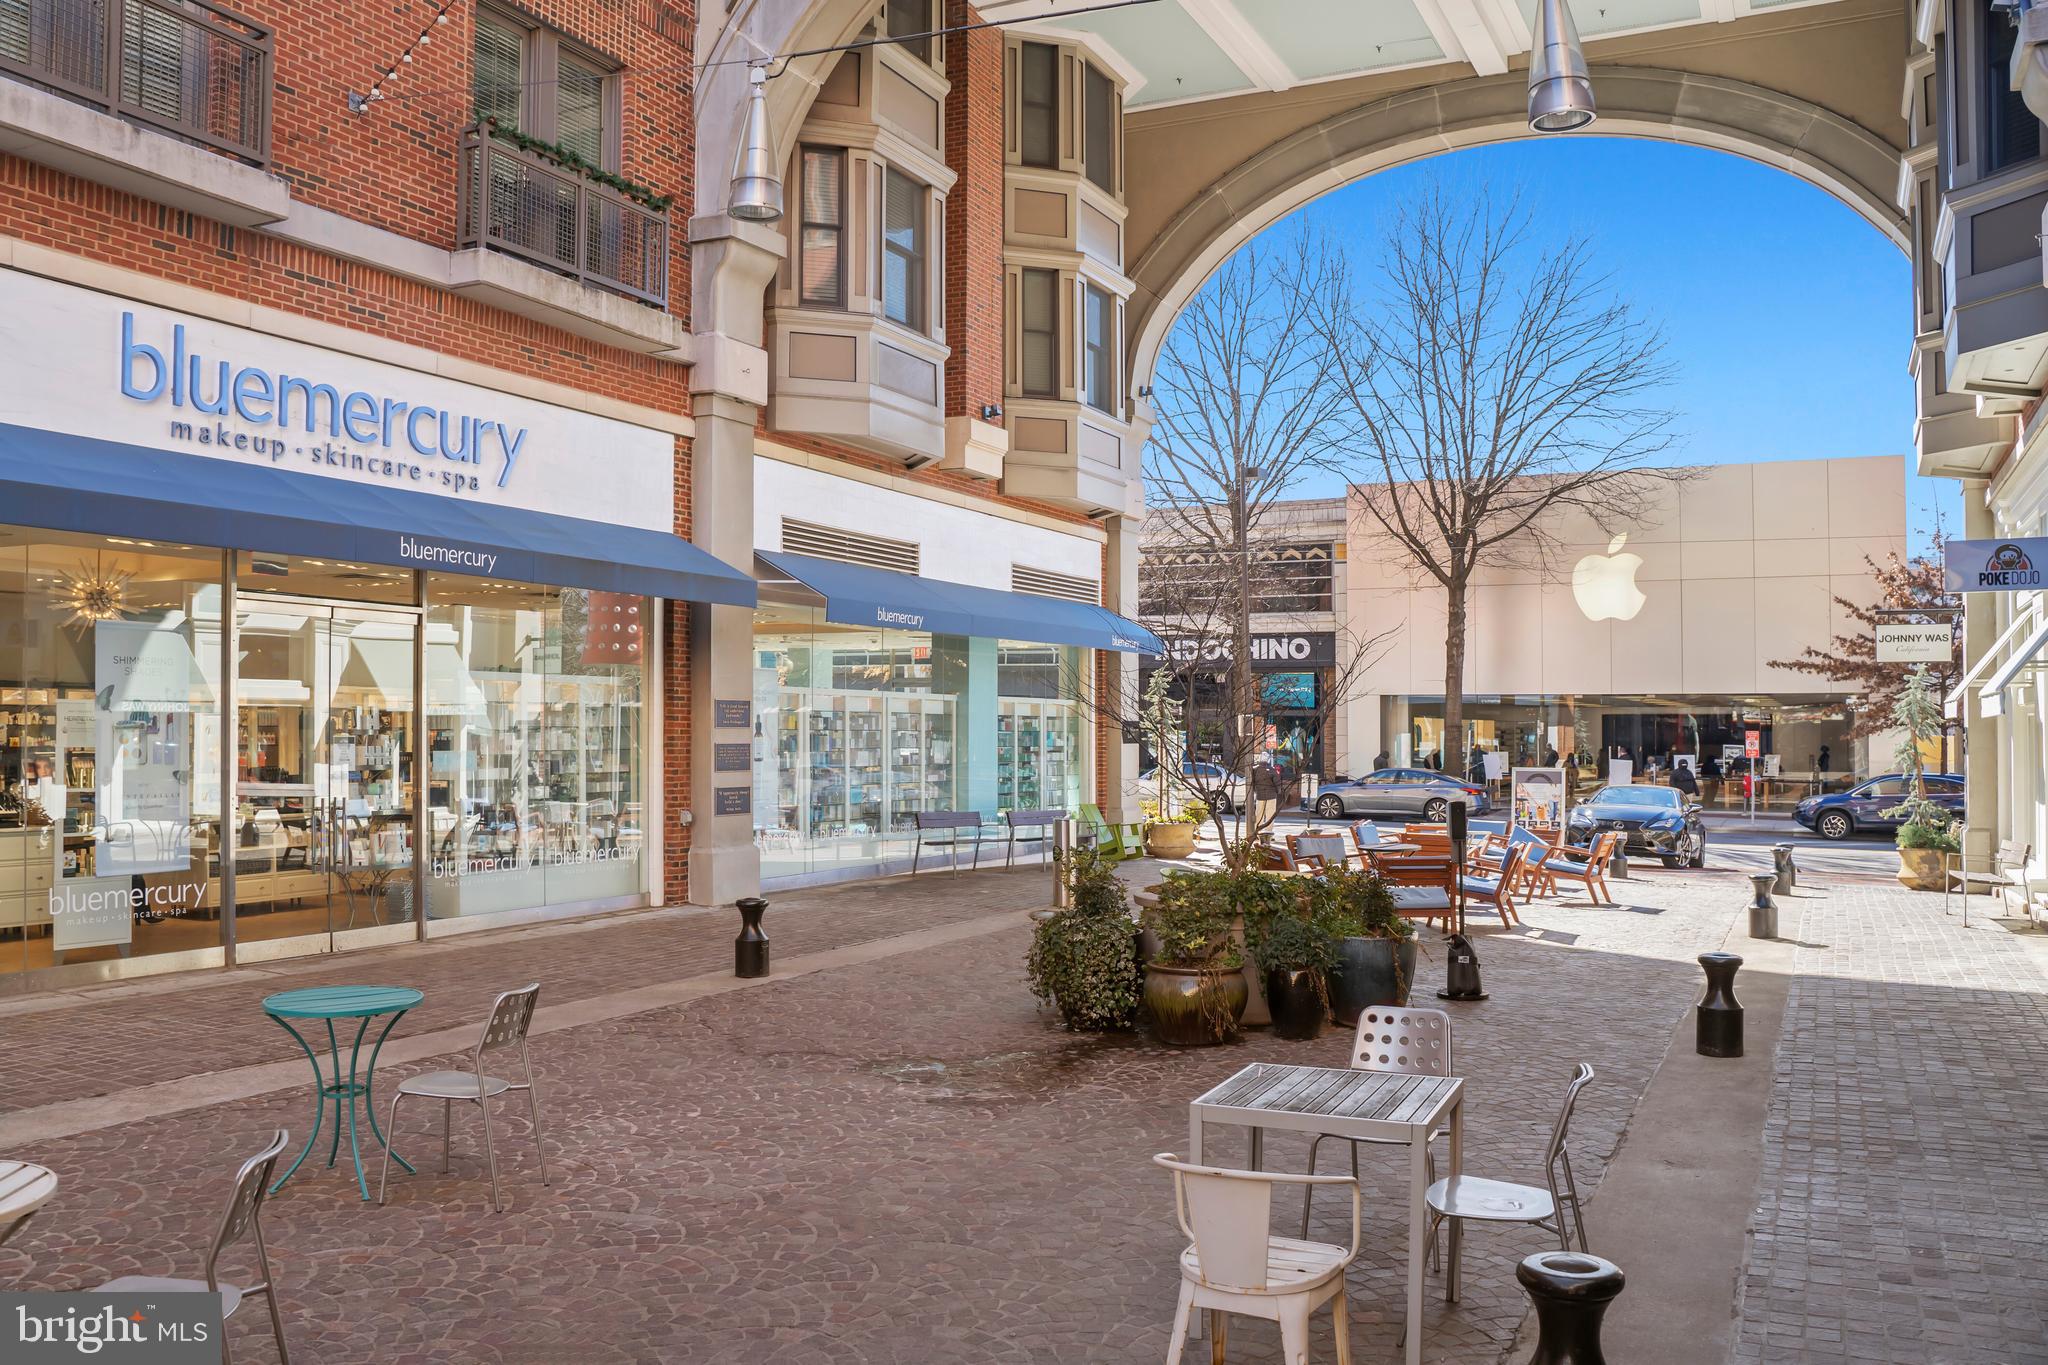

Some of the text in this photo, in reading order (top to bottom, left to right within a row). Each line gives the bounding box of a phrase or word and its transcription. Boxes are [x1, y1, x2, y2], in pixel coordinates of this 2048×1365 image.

[121, 311, 528, 487] bluemercury
[170, 420, 480, 493] makeup skincare spa
[400, 536, 497, 573] bluemercury
[1979, 570, 2040, 586] POKE DOJO
[877, 607, 924, 629] bluemercury
[1878, 633, 1949, 643] JOHNNY WAS
[434, 855, 535, 879] bluemercury
[48, 882, 207, 916] bluemercury
[66, 906, 188, 928] makeup skincare spa
